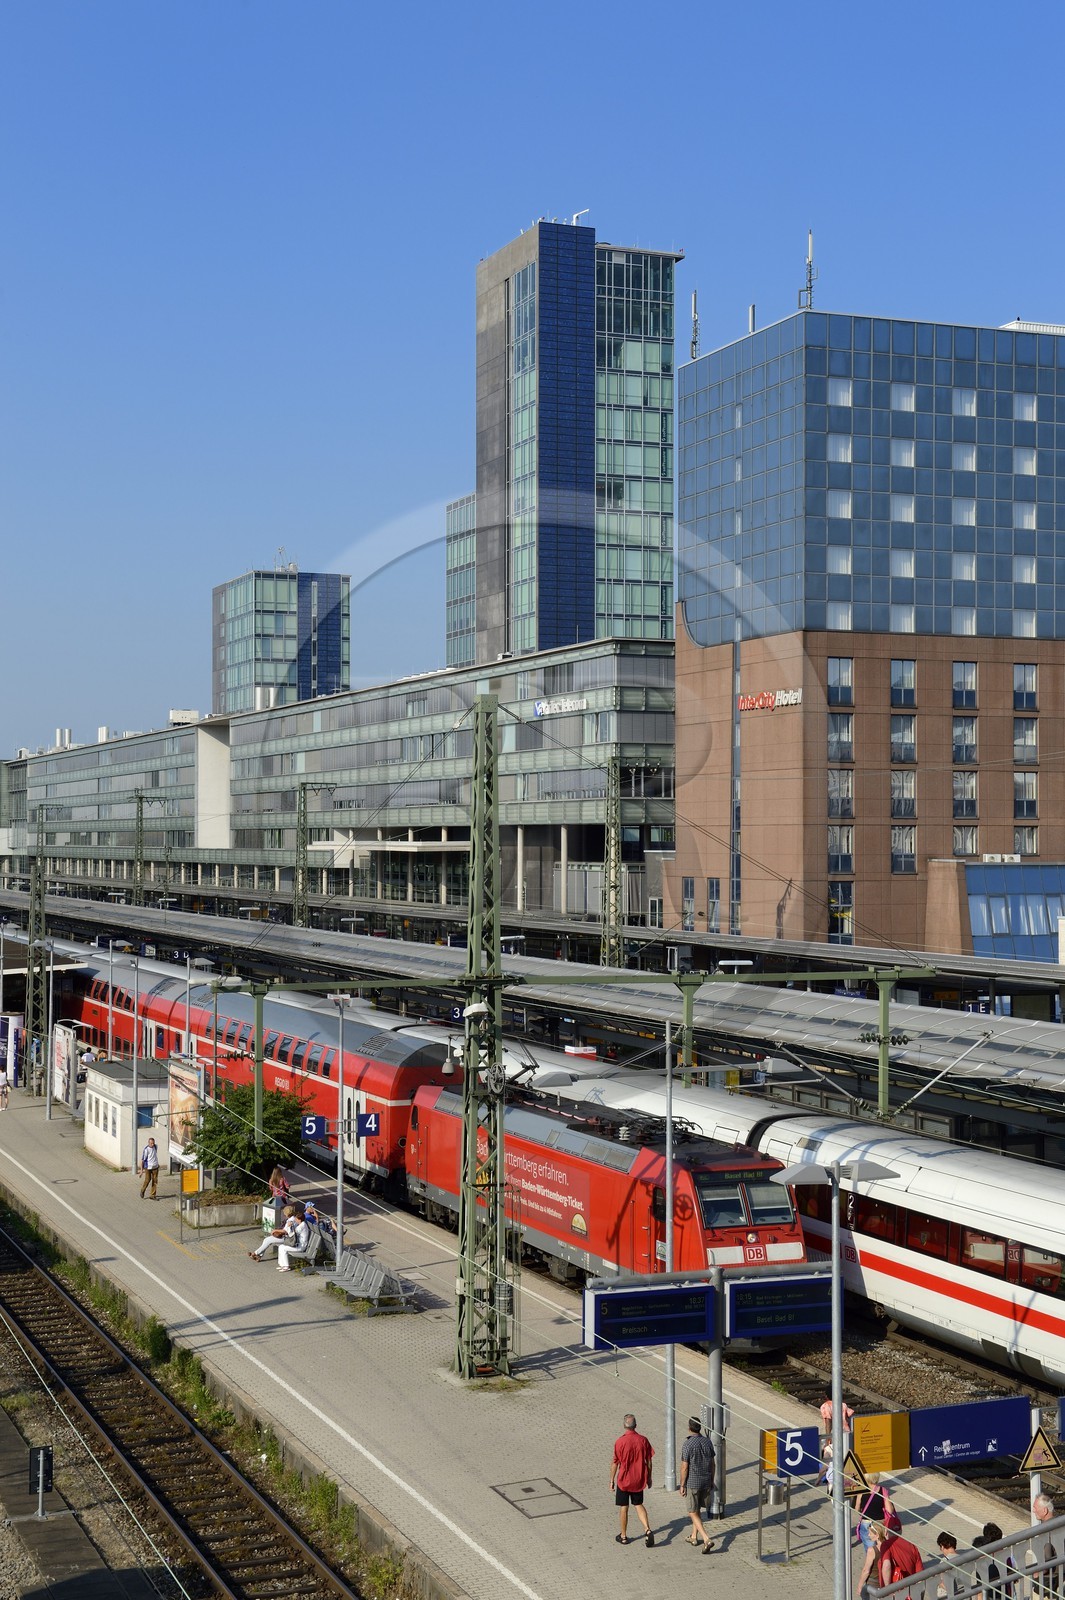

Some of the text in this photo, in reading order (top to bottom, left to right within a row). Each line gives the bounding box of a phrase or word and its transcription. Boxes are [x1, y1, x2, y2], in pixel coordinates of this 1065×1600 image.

[173, 950, 179, 959] 3
[453, 1007, 460, 1019] 3
[979, 1003, 986, 1013] E
[304, 1116, 317, 1135] 5
[365, 1113, 377, 1132] 4
[538, 1161, 570, 1186] erfahren.
[848, 1194, 855, 1209] 2
[746, 1247, 764, 1260] DB
[846, 1248, 855, 1261] DB
[601, 1302, 608, 1316] 5
[784, 1430, 804, 1467] 5
